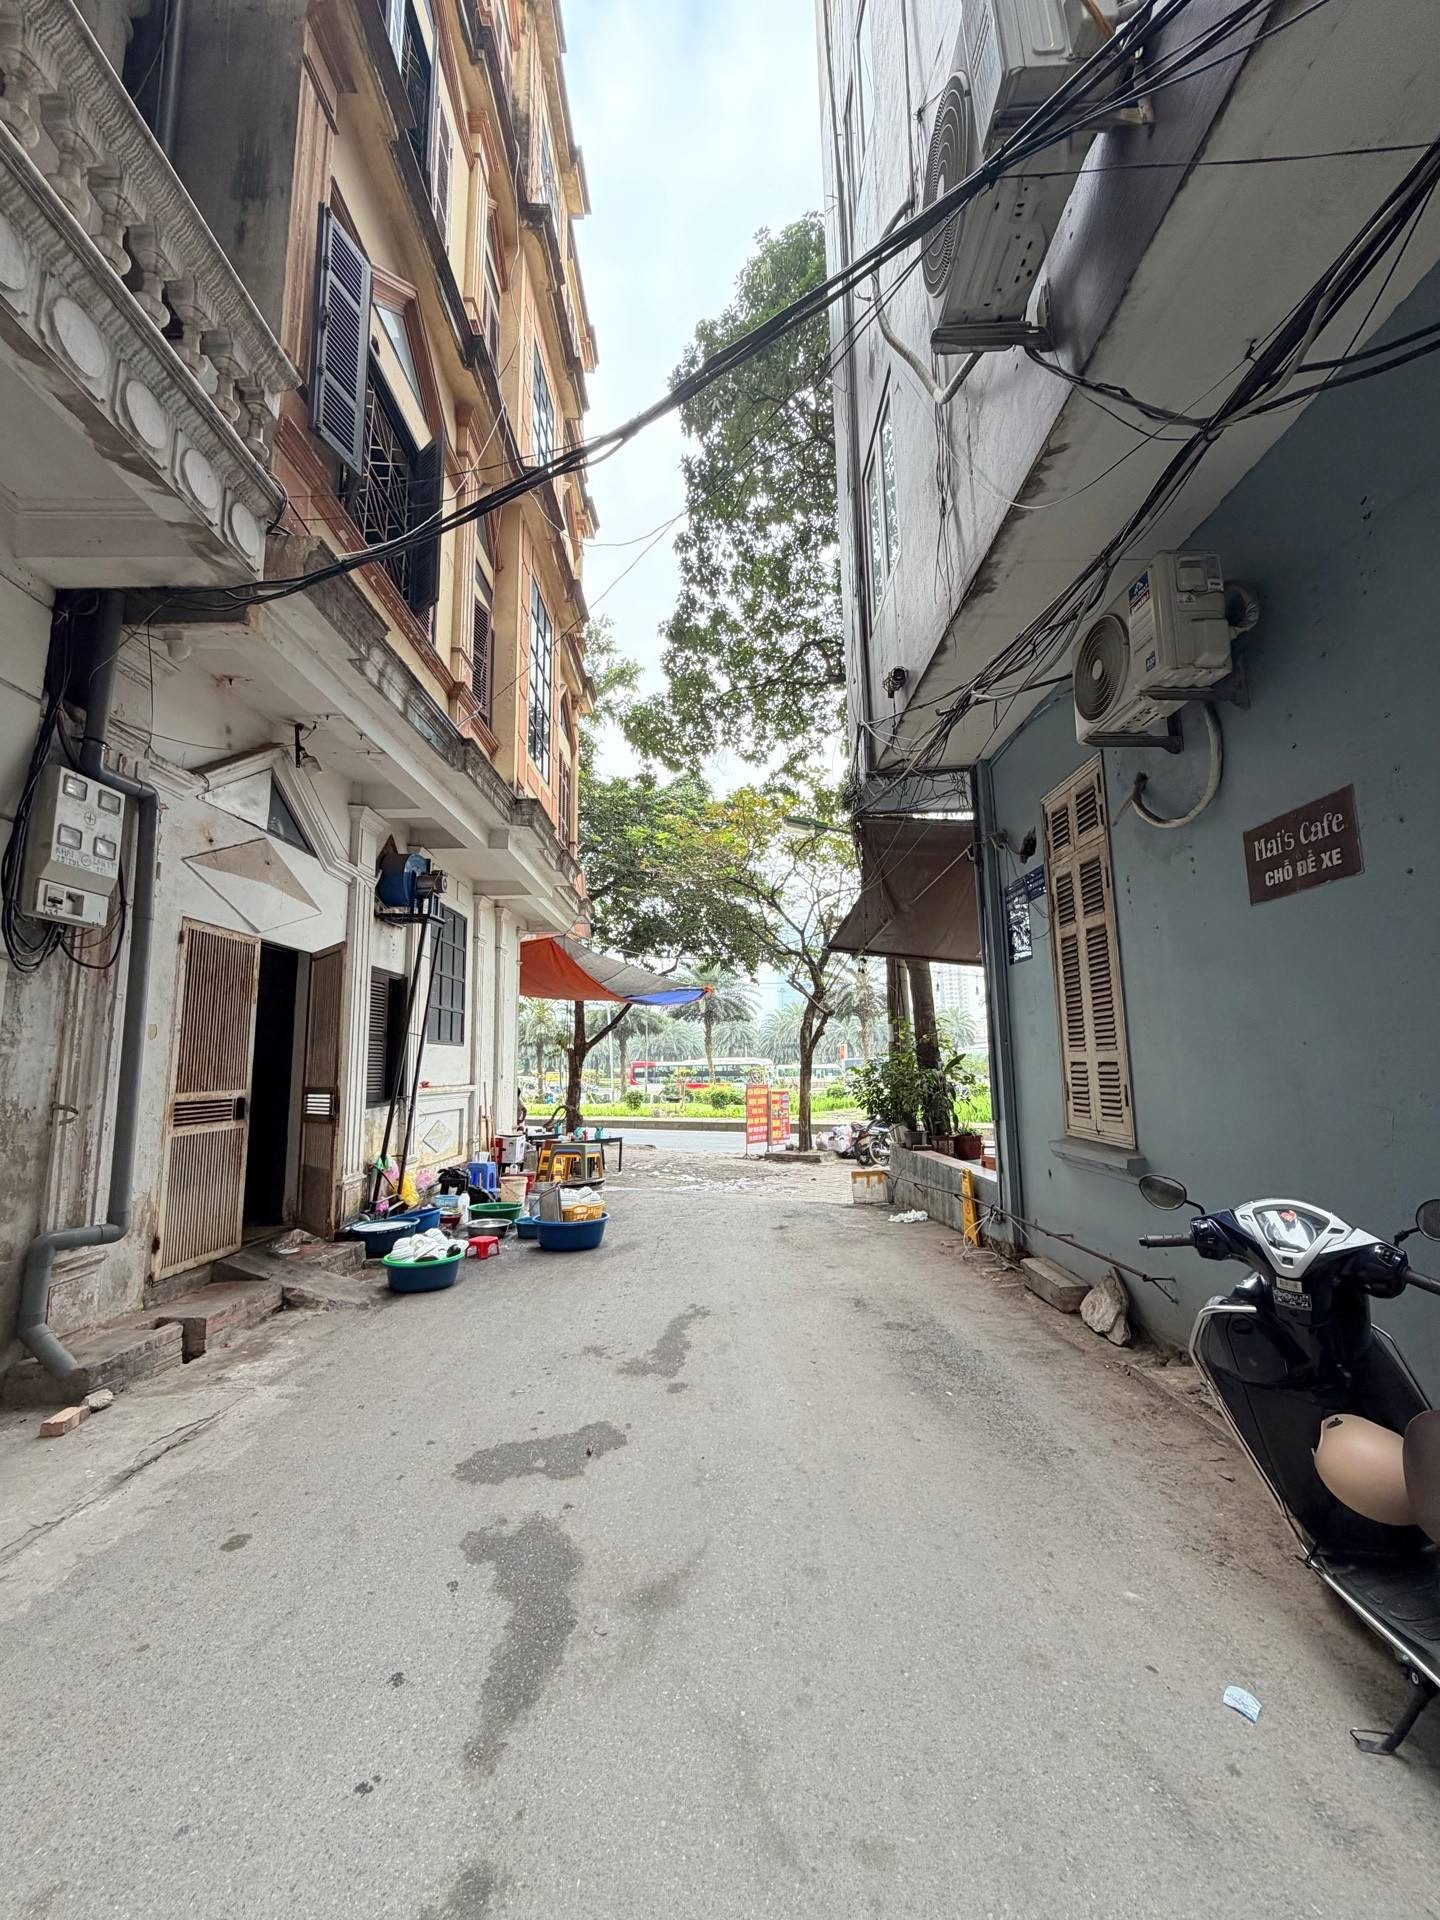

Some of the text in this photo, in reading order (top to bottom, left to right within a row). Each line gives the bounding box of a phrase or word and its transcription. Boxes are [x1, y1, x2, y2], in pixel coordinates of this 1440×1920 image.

[1254, 812, 1345, 862] Mai's Cafe
[1265, 859, 1293, 887] CHỖ
[1320, 848, 1342, 869] XE
